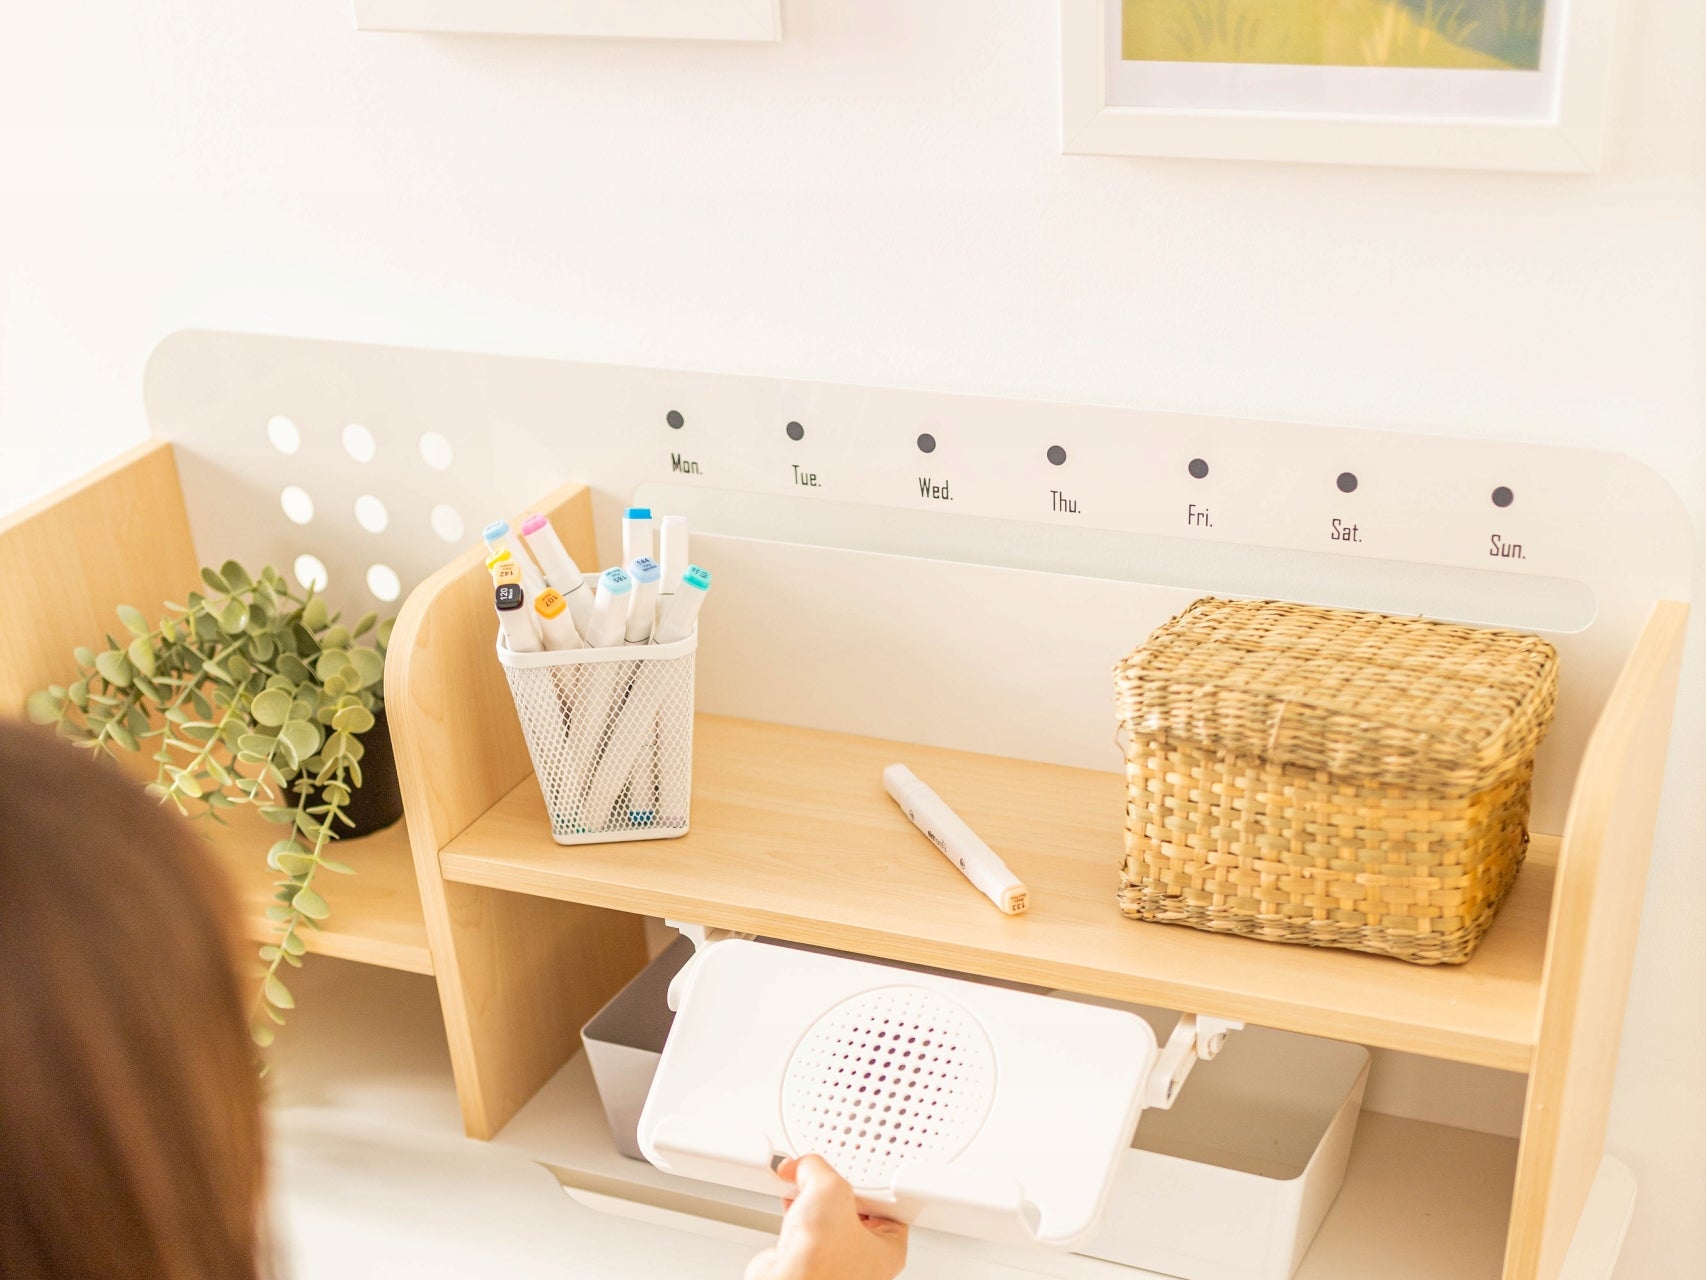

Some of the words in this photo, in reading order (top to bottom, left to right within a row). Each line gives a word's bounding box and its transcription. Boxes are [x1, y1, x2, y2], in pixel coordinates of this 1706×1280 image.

[670, 453, 703, 476] Mon.
[791, 464, 822, 488] Tue.
[918, 477, 954, 501] Wed.
[1050, 490, 1081, 514] Thu.
[1187, 504, 1213, 528] Fri.
[1331, 518, 1363, 543] Sat.
[1489, 534, 1526, 560] Sun.
[499, 570, 514, 578] 142
[500, 587, 509, 600] 120
[544, 594, 558, 608] 107
[1012, 902, 1026, 911] 133
